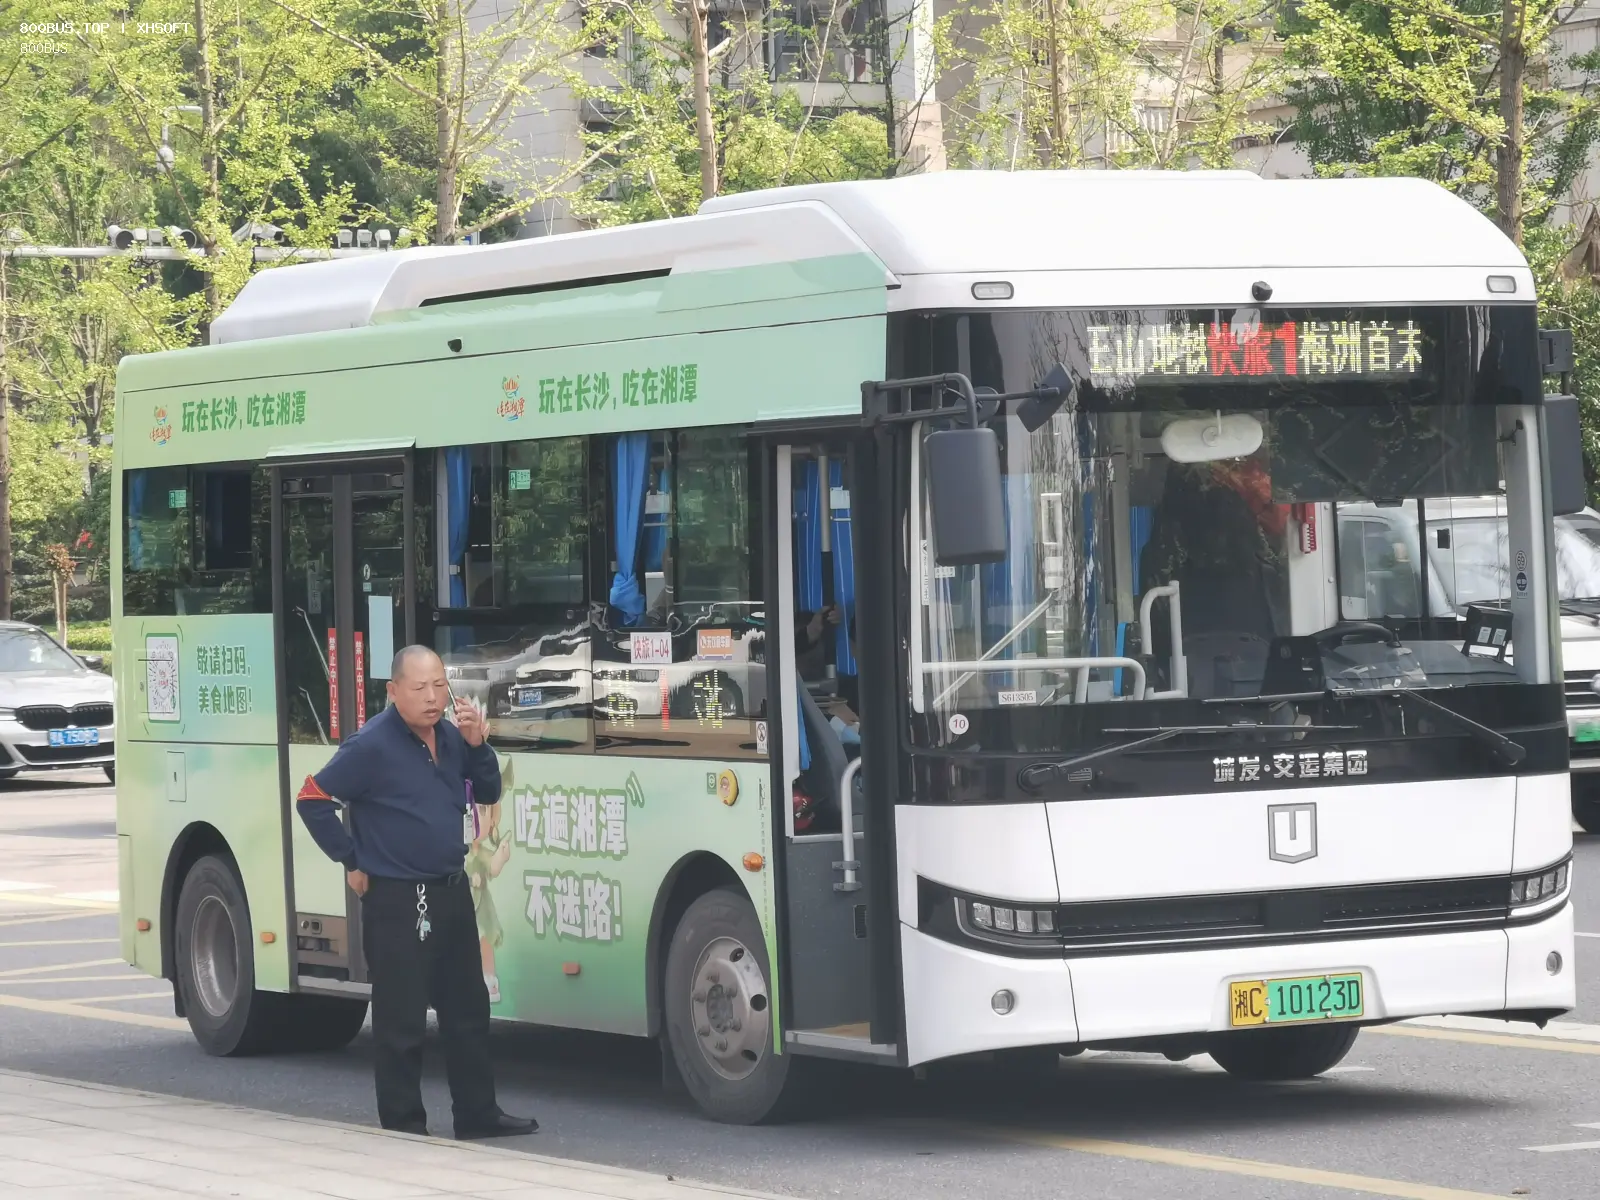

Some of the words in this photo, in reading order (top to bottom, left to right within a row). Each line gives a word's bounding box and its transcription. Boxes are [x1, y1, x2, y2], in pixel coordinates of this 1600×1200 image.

[539, 363, 698, 415] 玩在长沙，吃在湘潭
[181, 390, 307, 433] 玩在长沙，吃在湘潭
[1001, 692, 1034, 703] S613505
[953, 718, 966, 729] 10
[514, 788, 628, 856] 吃遍湘潭
